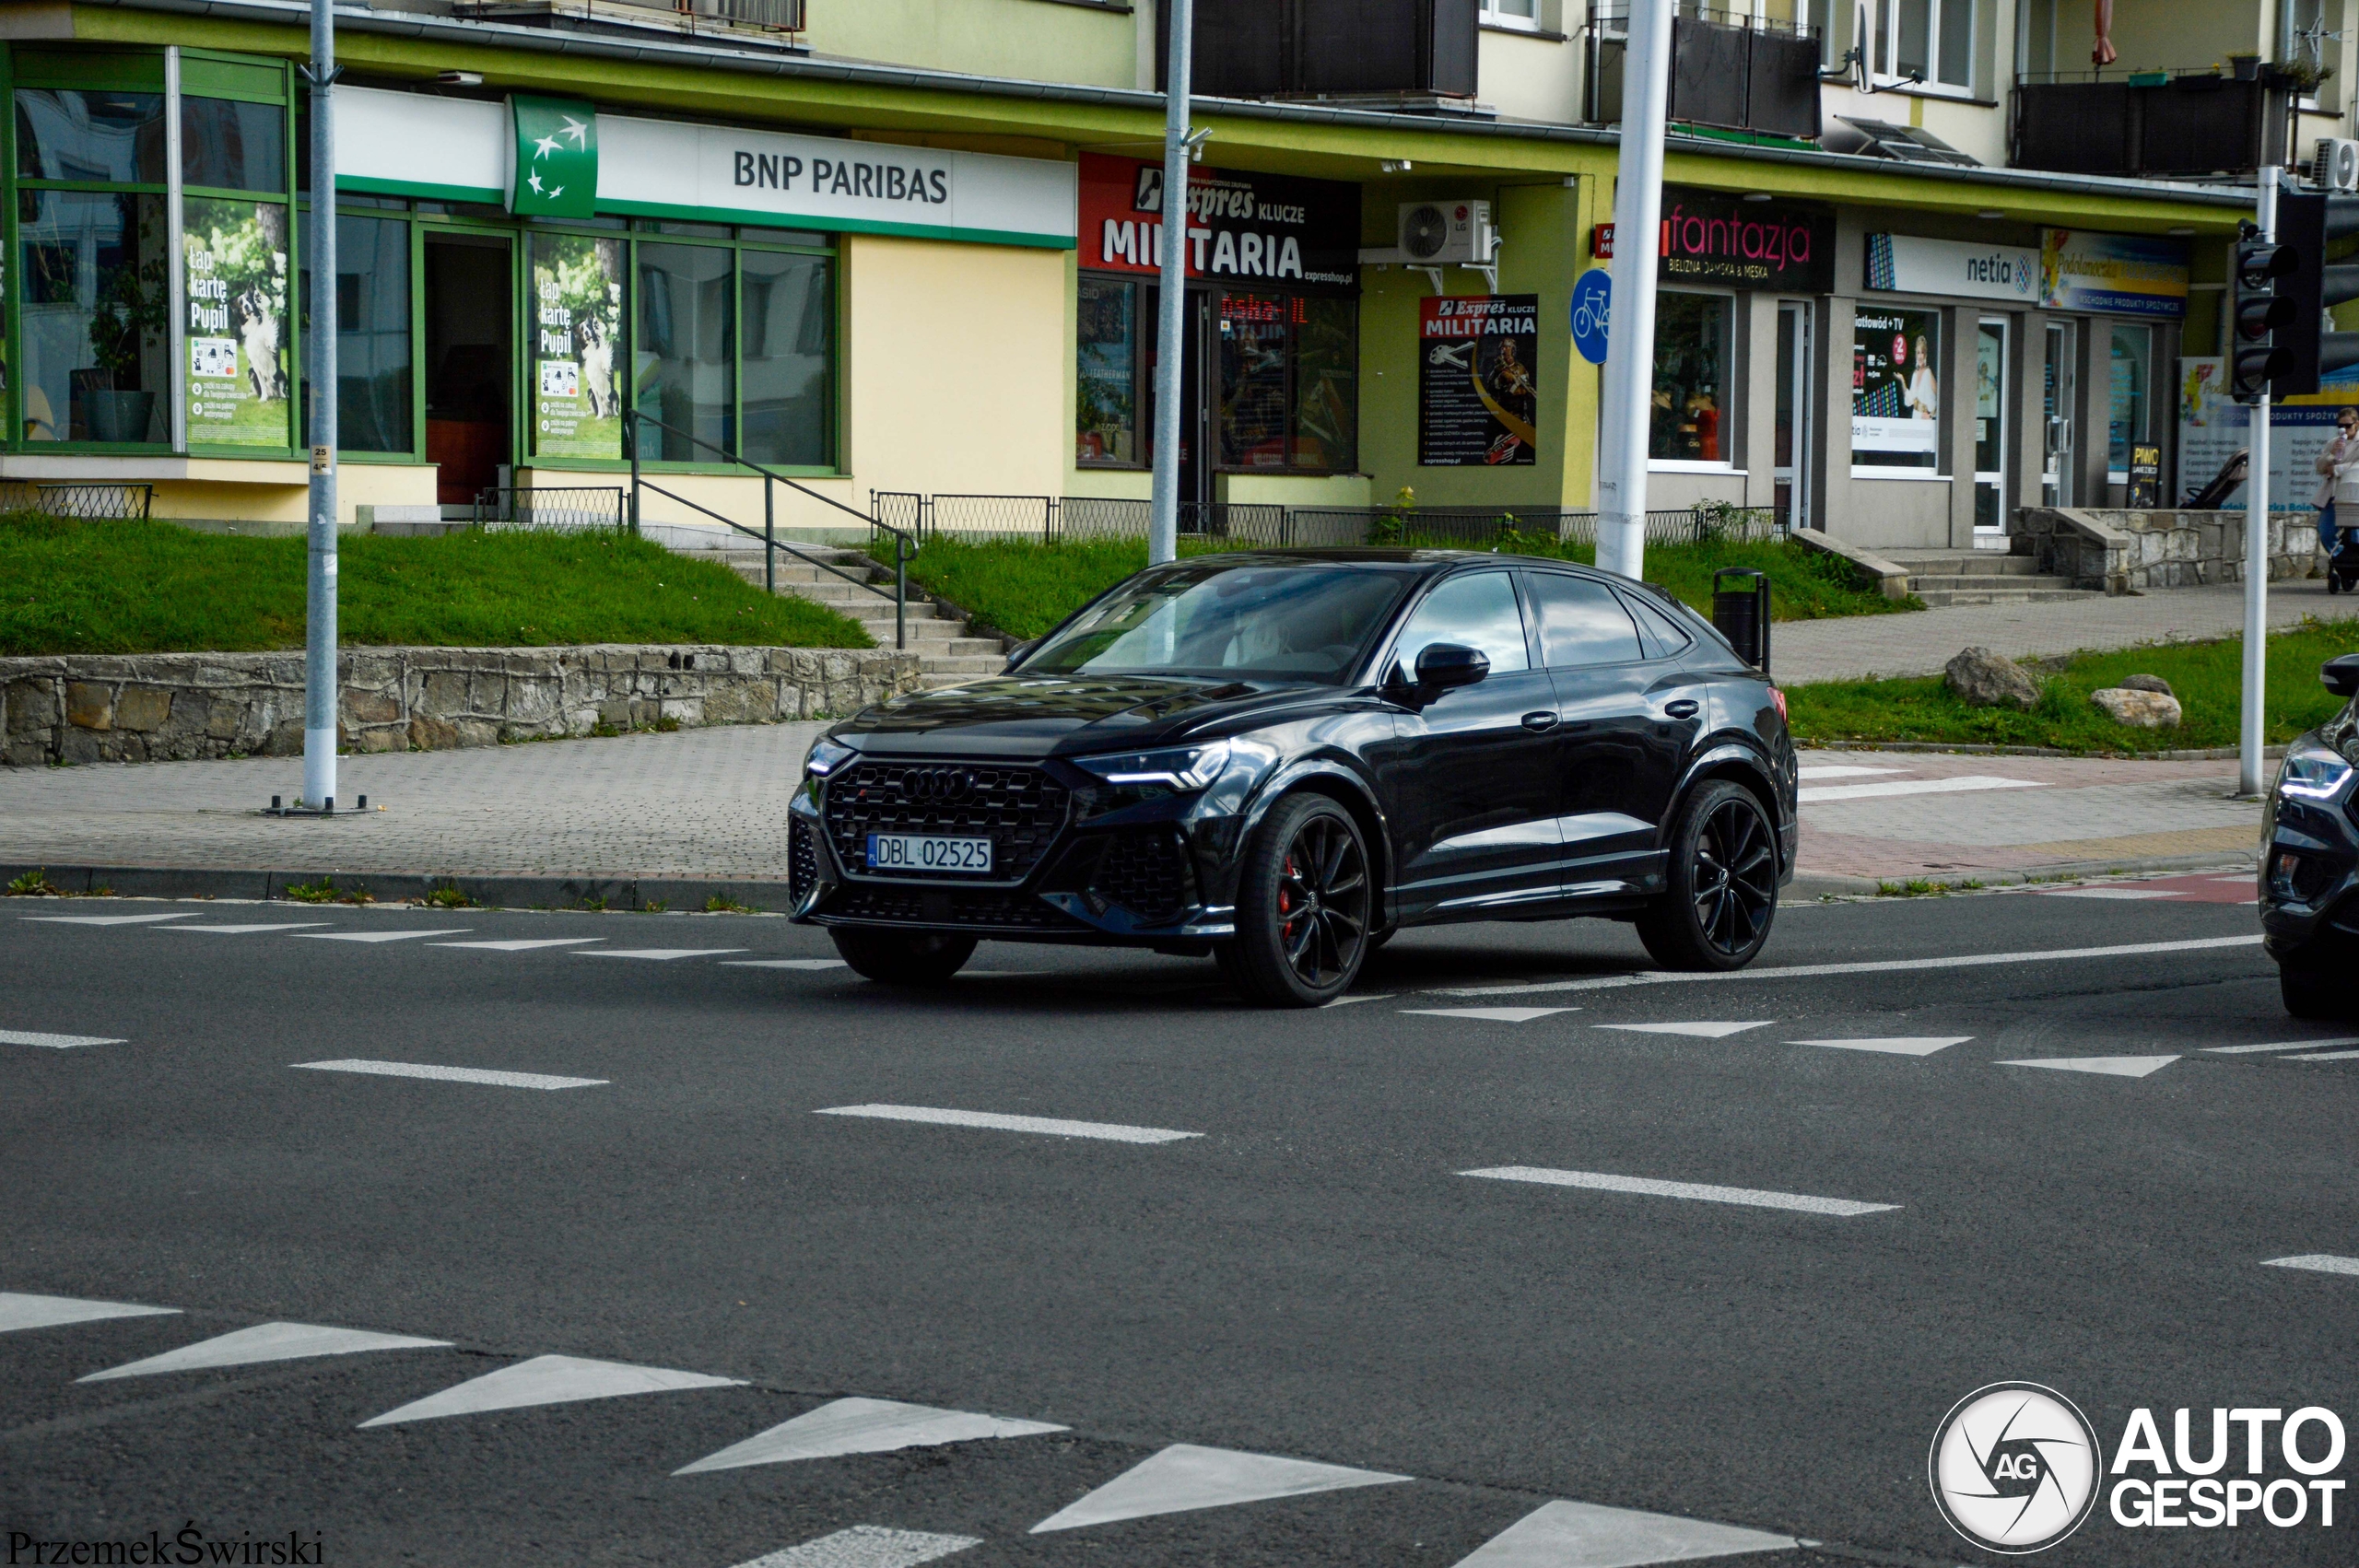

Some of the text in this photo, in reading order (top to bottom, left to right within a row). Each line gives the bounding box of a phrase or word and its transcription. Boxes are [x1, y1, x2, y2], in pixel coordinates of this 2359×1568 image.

[734, 150, 947, 205] BNP PARIBAS
[1187, 186, 1306, 224] xpres KLUCZE
[1455, 223, 1467, 232] LG
[1670, 204, 1811, 272] fantazja
[1104, 218, 1304, 279] MITARIA
[189, 245, 212, 275] Łap
[1669, 258, 1701, 273] BIELIZNA
[1743, 264, 1768, 280] MĘSKA
[1967, 253, 2011, 284] netia
[190, 273, 227, 302] kartę
[1304, 271, 1353, 285] expresshop.pl
[539, 276, 559, 304] Łap
[1078, 287, 1100, 299] SIO
[1455, 300, 1536, 318] Expres KLUCZE
[2079, 295, 2179, 311] WSCHODNIE PRODUKTY SPOŻYWCZE
[191, 302, 229, 333] Pupil
[540, 302, 571, 330] kartę
[1855, 313, 1887, 329] iatłowód
[1893, 317, 1904, 331] TV
[1426, 317, 1536, 336] MILITARIA
[540, 329, 571, 357] Pupil
[1896, 337, 1904, 353] 2
[1089, 369, 1131, 380] LEATHERMAN
[2270, 412, 2303, 421] ODUKTY
[2306, 410, 2339, 421] SPOŻYW
[315, 448, 327, 456] 25
[2133, 447, 2159, 465] PIWO
[868, 853, 876, 861] PL
[877, 838, 989, 868] DBL 02525
